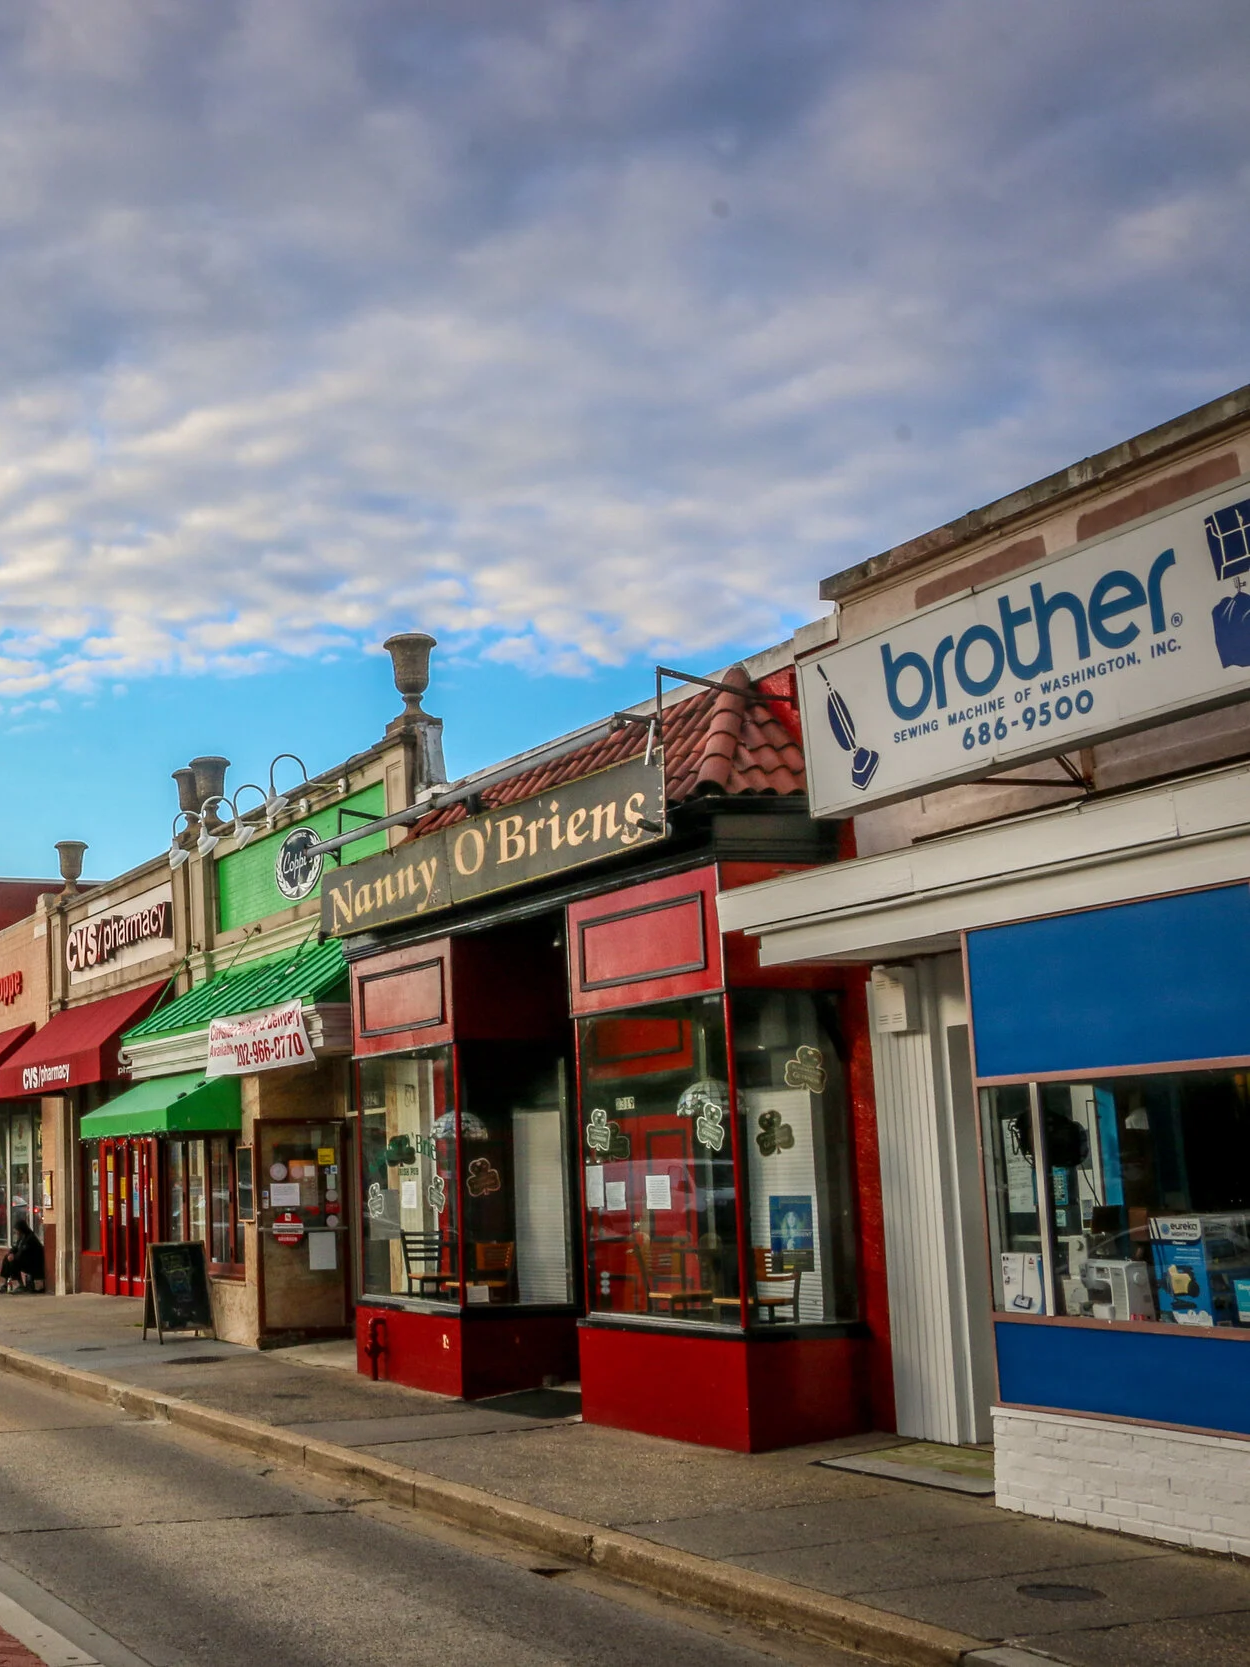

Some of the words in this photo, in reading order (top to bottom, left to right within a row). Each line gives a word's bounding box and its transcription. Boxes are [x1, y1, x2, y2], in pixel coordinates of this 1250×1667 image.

[880, 548, 1176, 721] brother
[893, 718, 940, 744] SEWING
[948, 696, 1006, 727] MACHINE
[1014, 687, 1033, 704] OF
[1040, 652, 1142, 696] WASHINGTON,
[1151, 638, 1182, 660] INC.
[961, 689, 1095, 751] 686-9500
[328, 855, 439, 932] Nanny
[454, 791, 646, 878] O'Briens
[66, 901, 169, 972] CVS/pharmacy
[234, 1032, 305, 1067] 202-966-0770
[267, 1009, 300, 1030] Delivery
[22, 1063, 70, 1090] CVS/pharmacy
[1170, 1220, 1198, 1231] eureka
